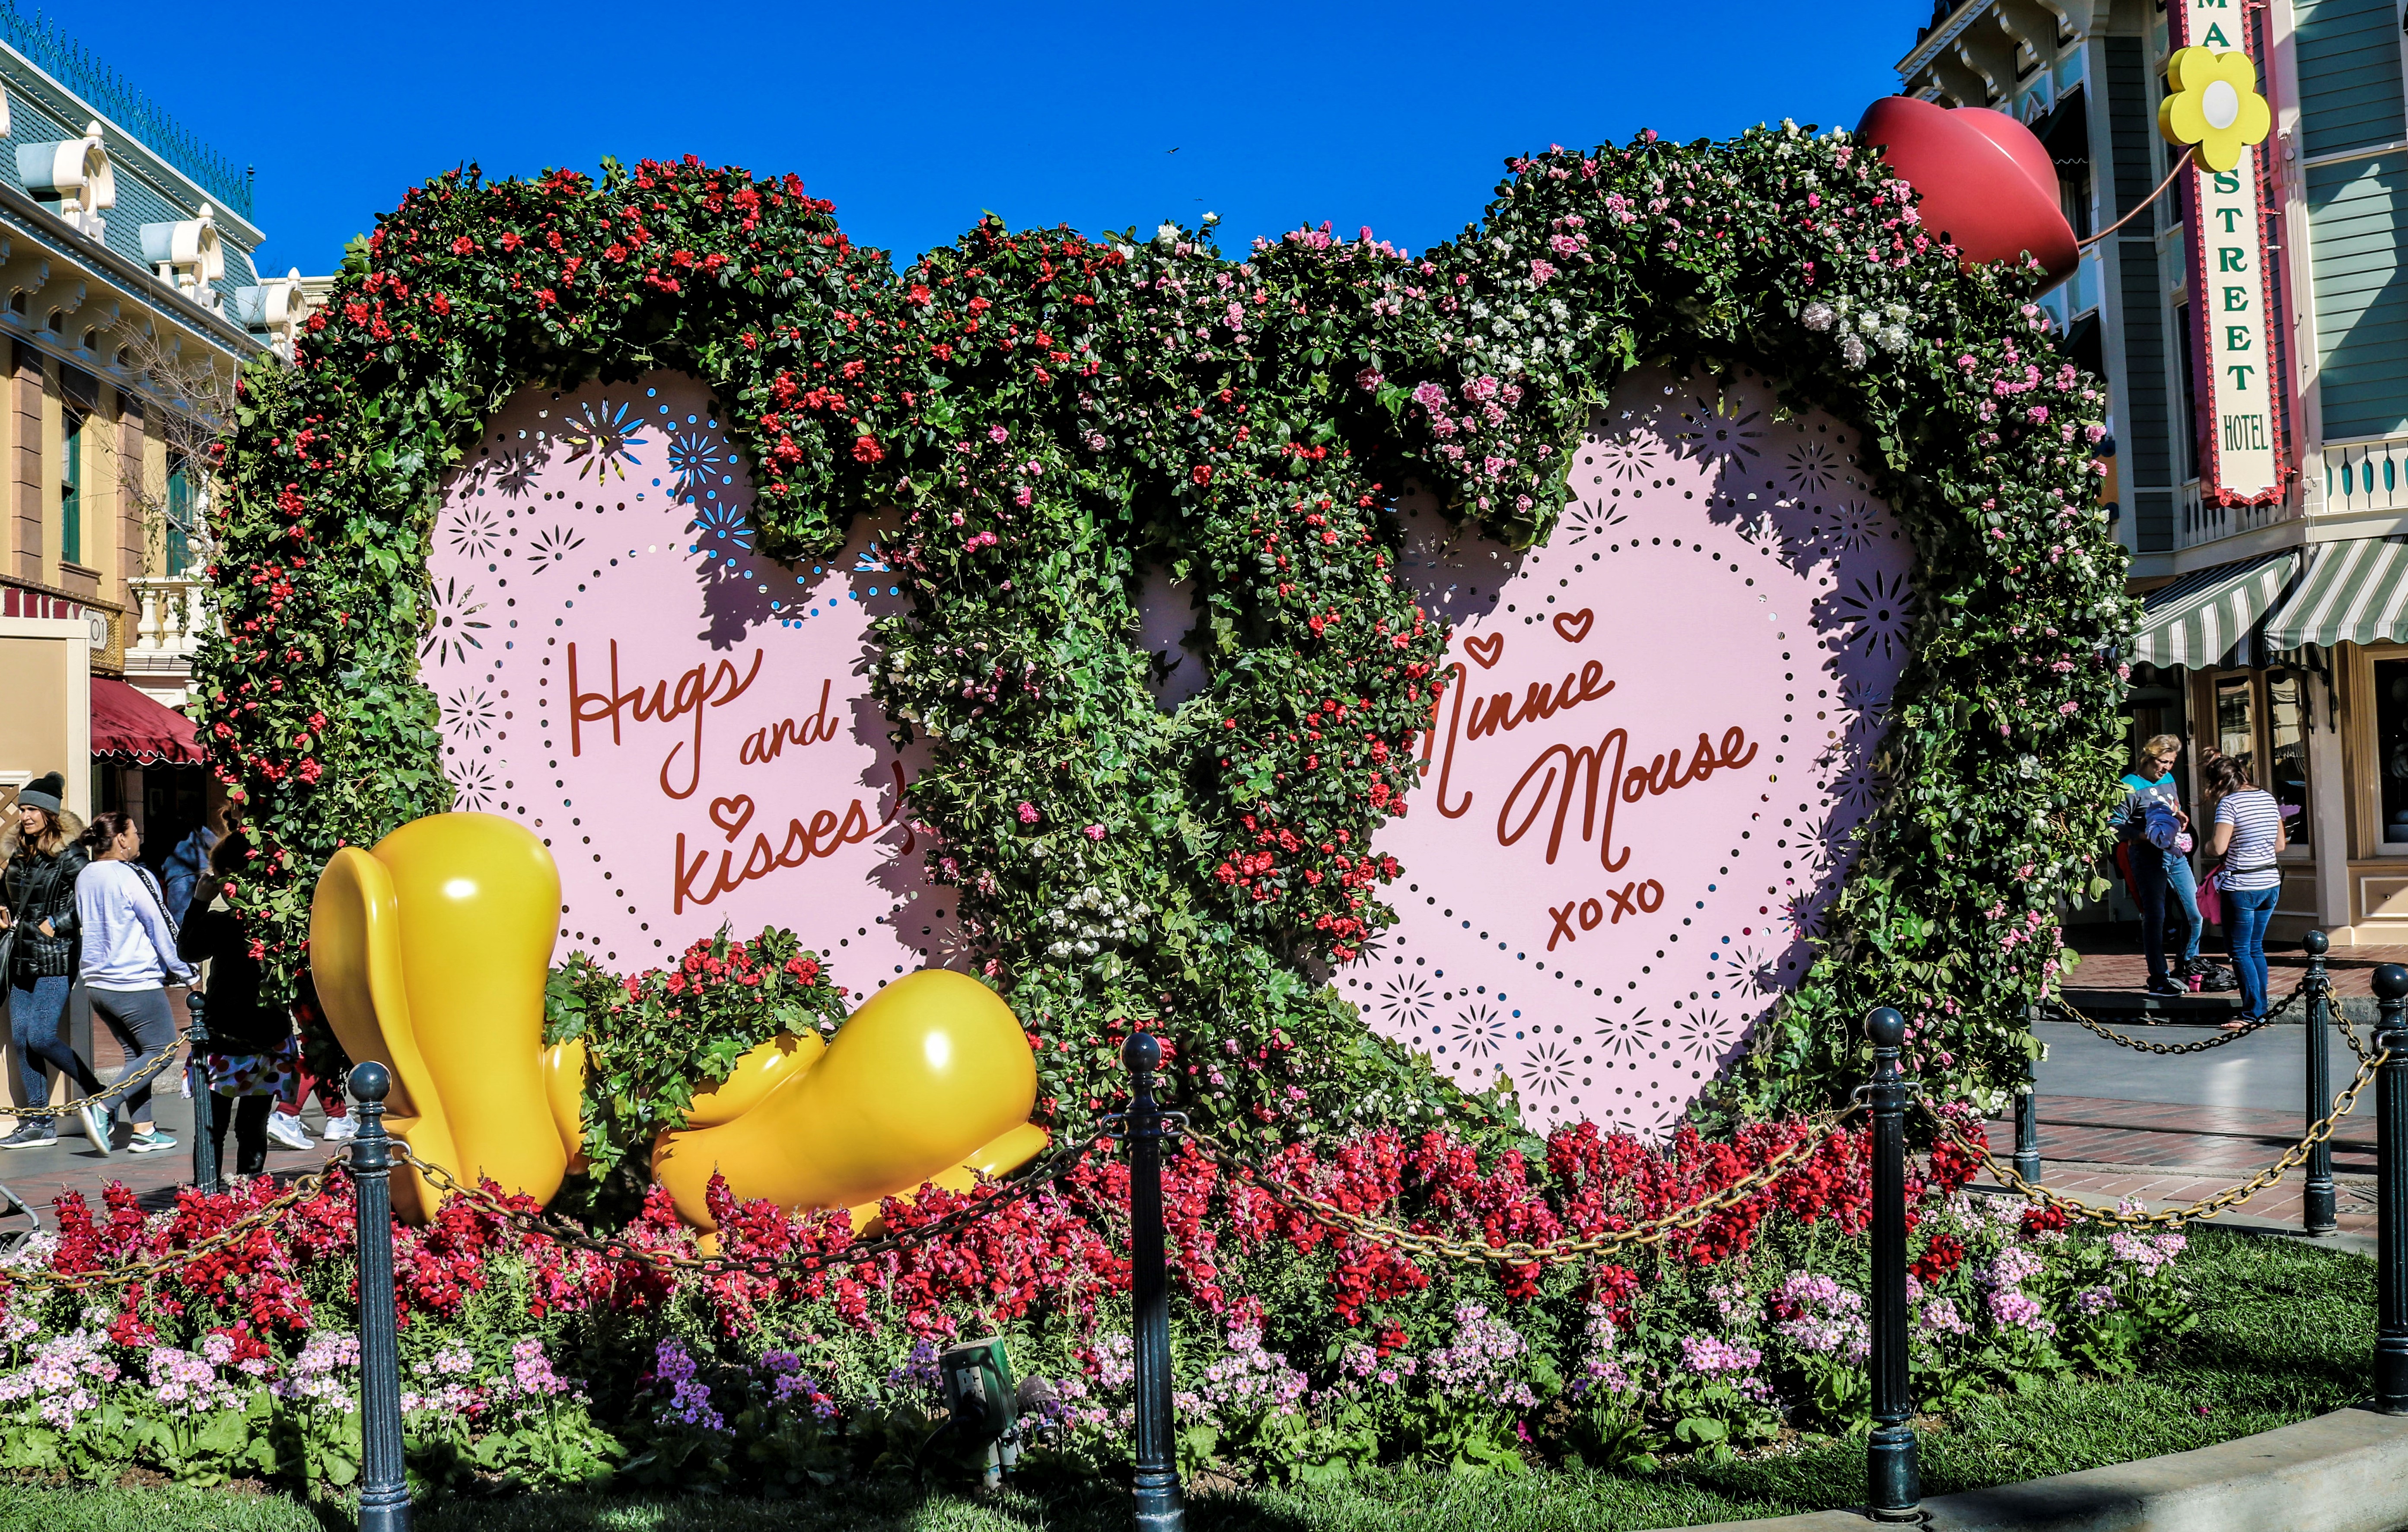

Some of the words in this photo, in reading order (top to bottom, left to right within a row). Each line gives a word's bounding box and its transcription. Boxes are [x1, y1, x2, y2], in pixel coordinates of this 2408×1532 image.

[2214, 169, 2254, 391] STREET
[2223, 414, 2268, 451] HOTEL
[88, 618, 105, 643] 01
[568, 638, 764, 800] Hugs
[739, 678, 839, 765] and
[1497, 726, 1758, 873] Mouse
